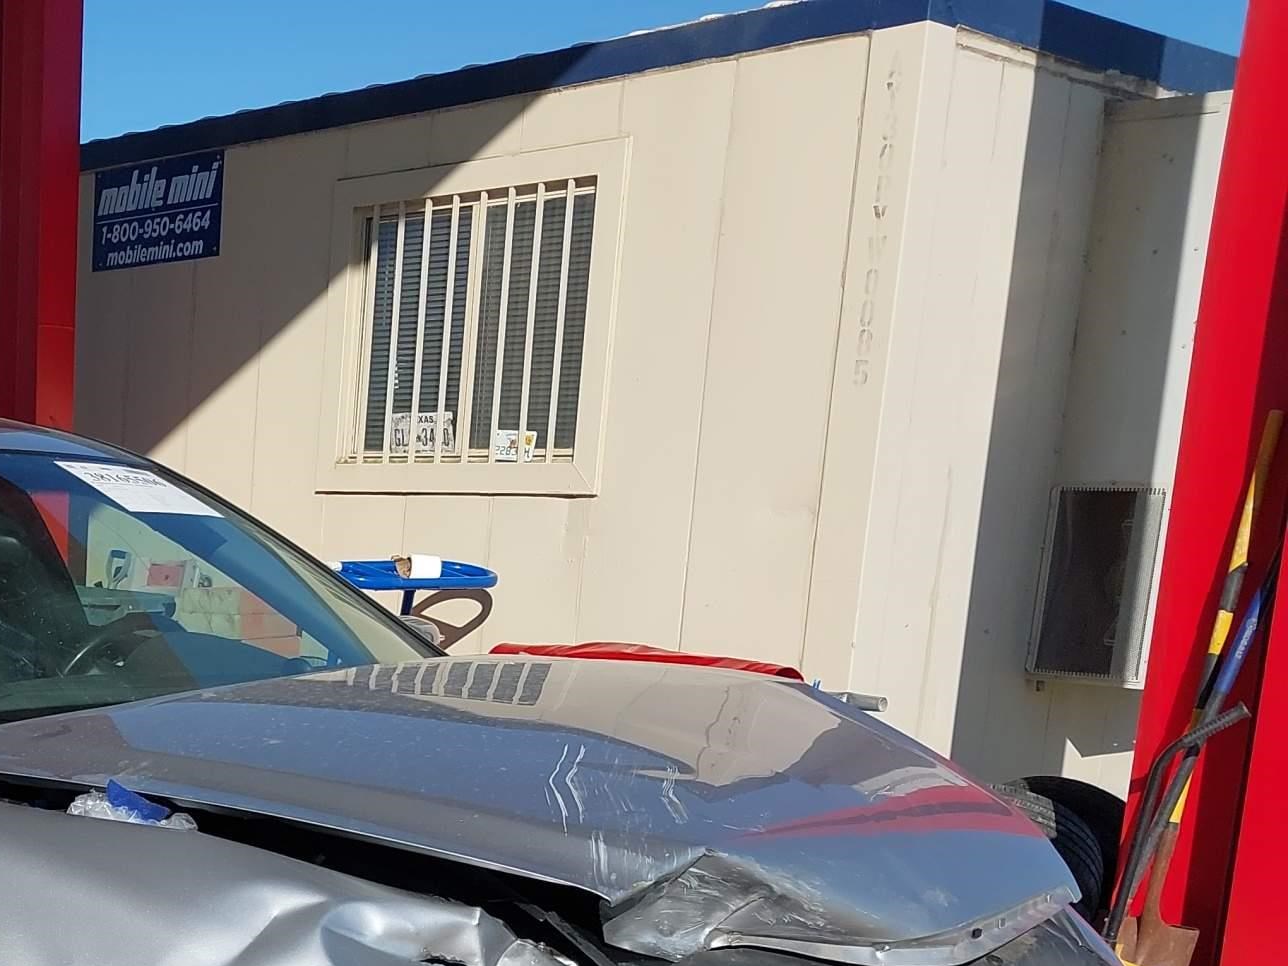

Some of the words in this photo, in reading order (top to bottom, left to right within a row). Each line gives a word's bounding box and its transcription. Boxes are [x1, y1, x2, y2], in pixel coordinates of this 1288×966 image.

[97, 166, 167, 217] mobile
[167, 161, 219, 205] mini
[101, 209, 211, 245] 1-800-950-6464
[106, 239, 204, 266] mobilemini.com
